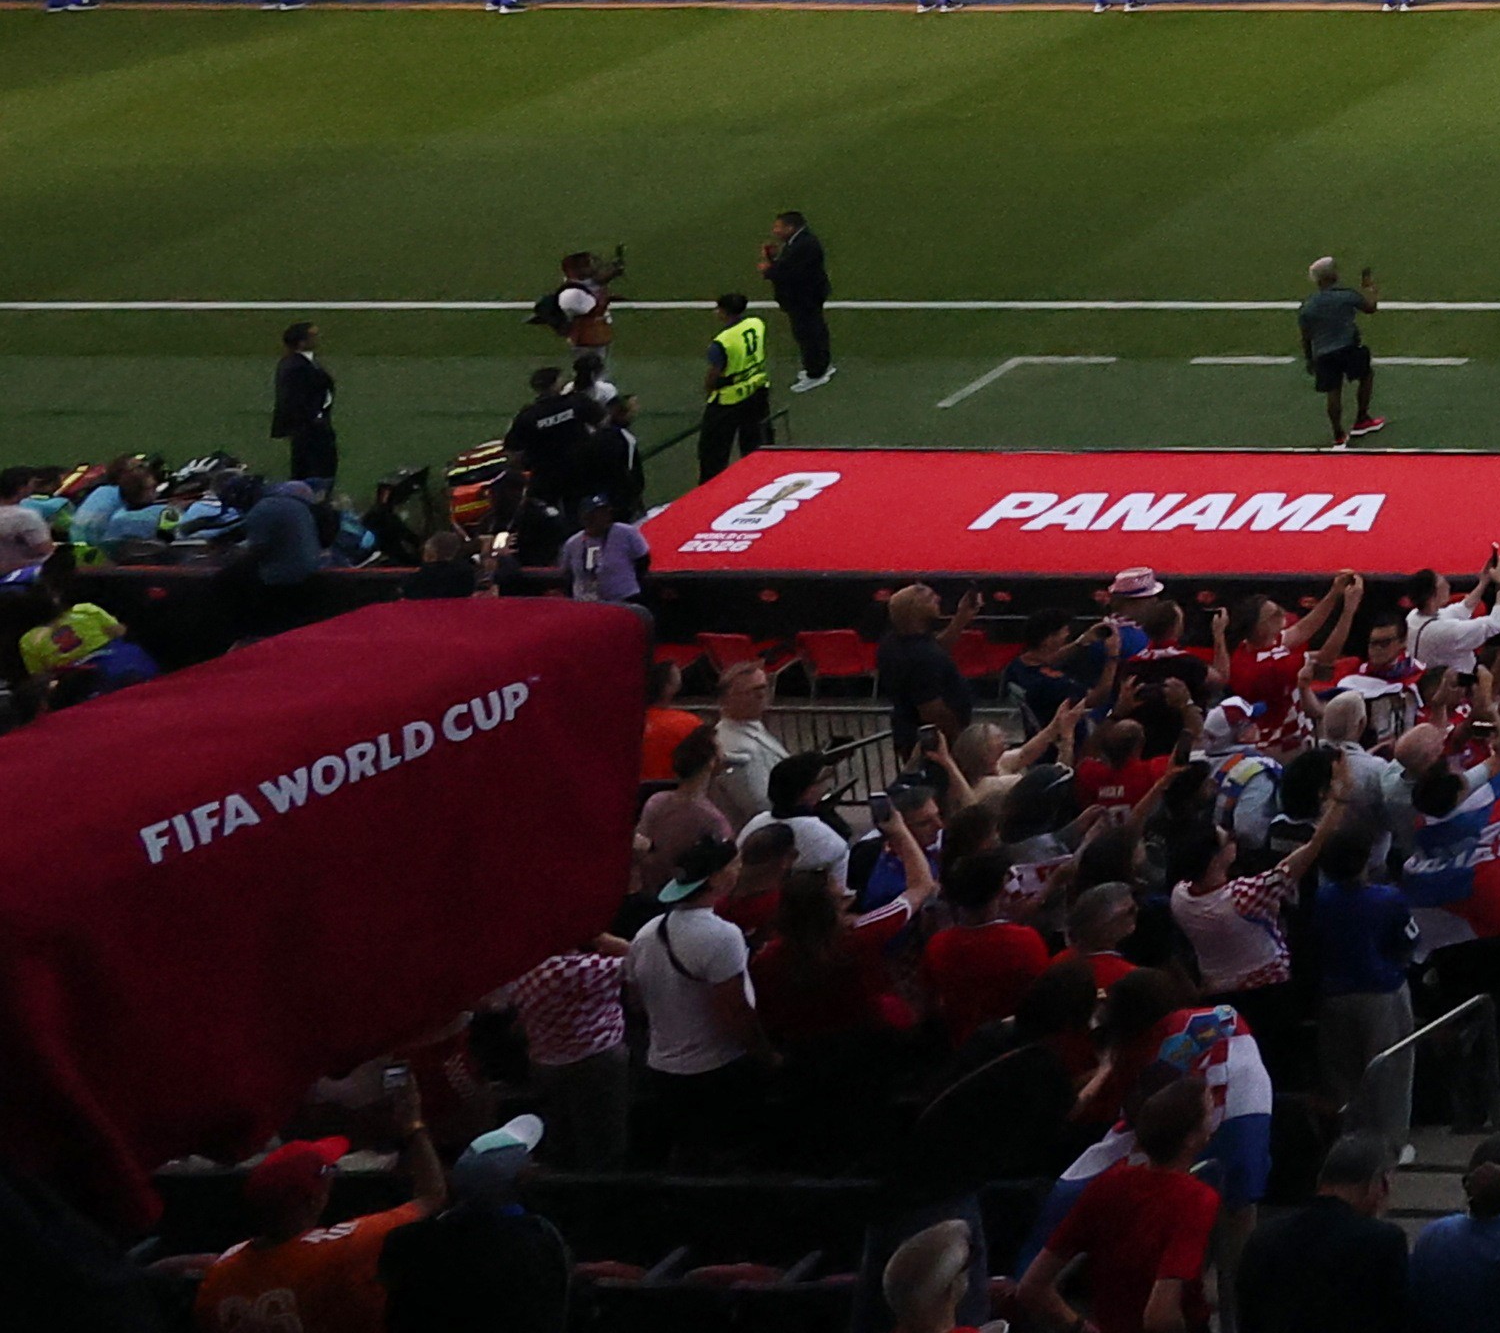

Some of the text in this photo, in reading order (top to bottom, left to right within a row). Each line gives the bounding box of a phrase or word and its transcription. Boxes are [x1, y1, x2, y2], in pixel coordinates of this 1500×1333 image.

[730, 516, 763, 526] FIFA
[967, 491, 1387, 533] PANAMA
[677, 540, 753, 553] 2026
[139, 680, 530, 865] FIFA WORLD CUP
